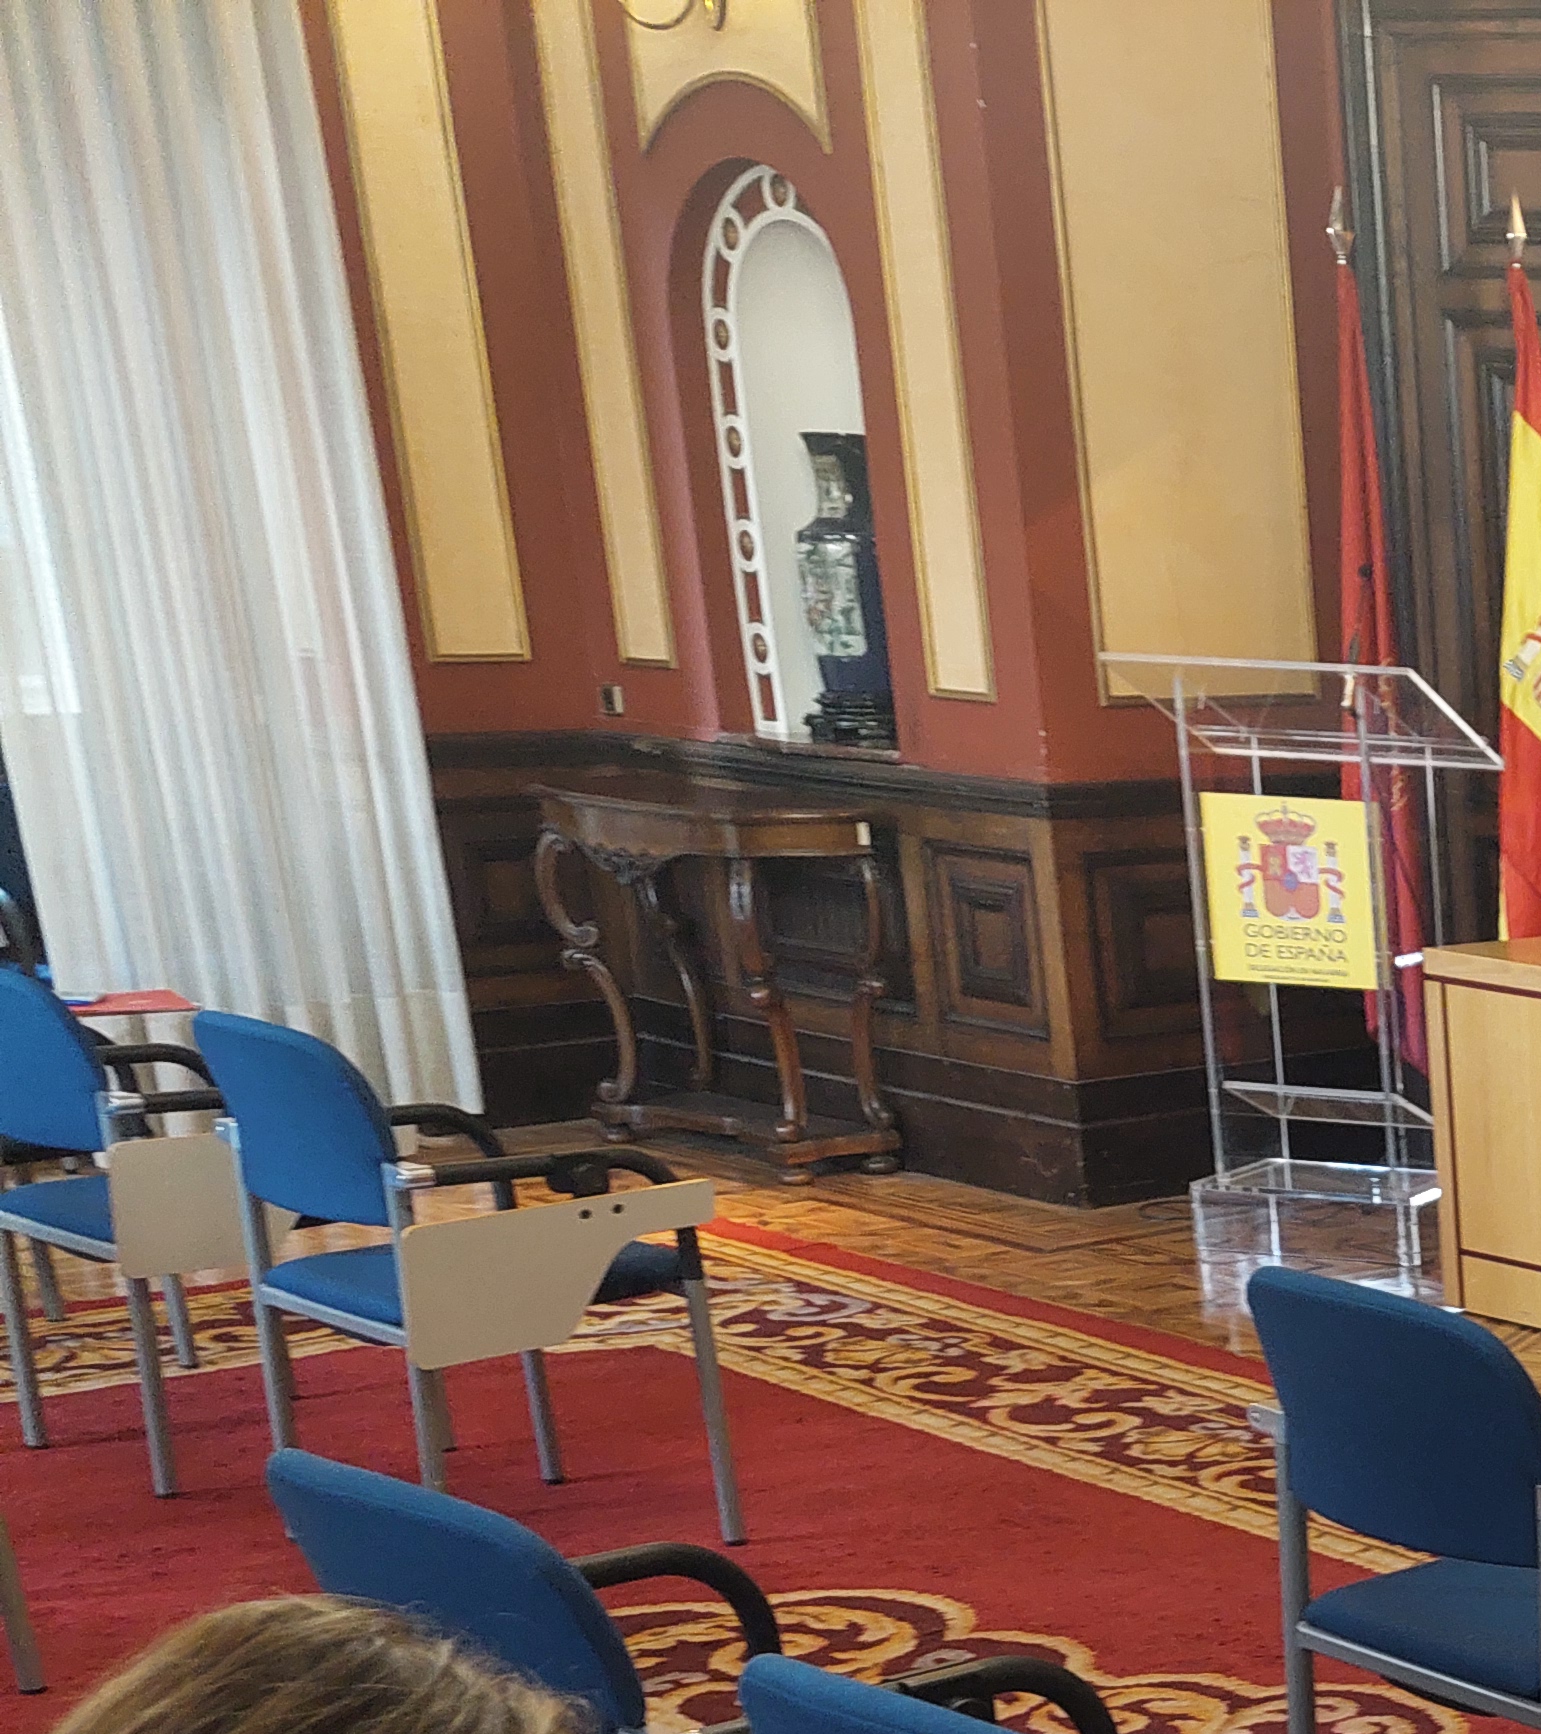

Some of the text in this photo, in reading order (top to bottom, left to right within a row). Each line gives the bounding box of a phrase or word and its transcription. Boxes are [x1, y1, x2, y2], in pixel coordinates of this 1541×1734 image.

[1244, 922, 1348, 943] GOBIERNO
[1245, 942, 1349, 963] DE ESPAÑA
